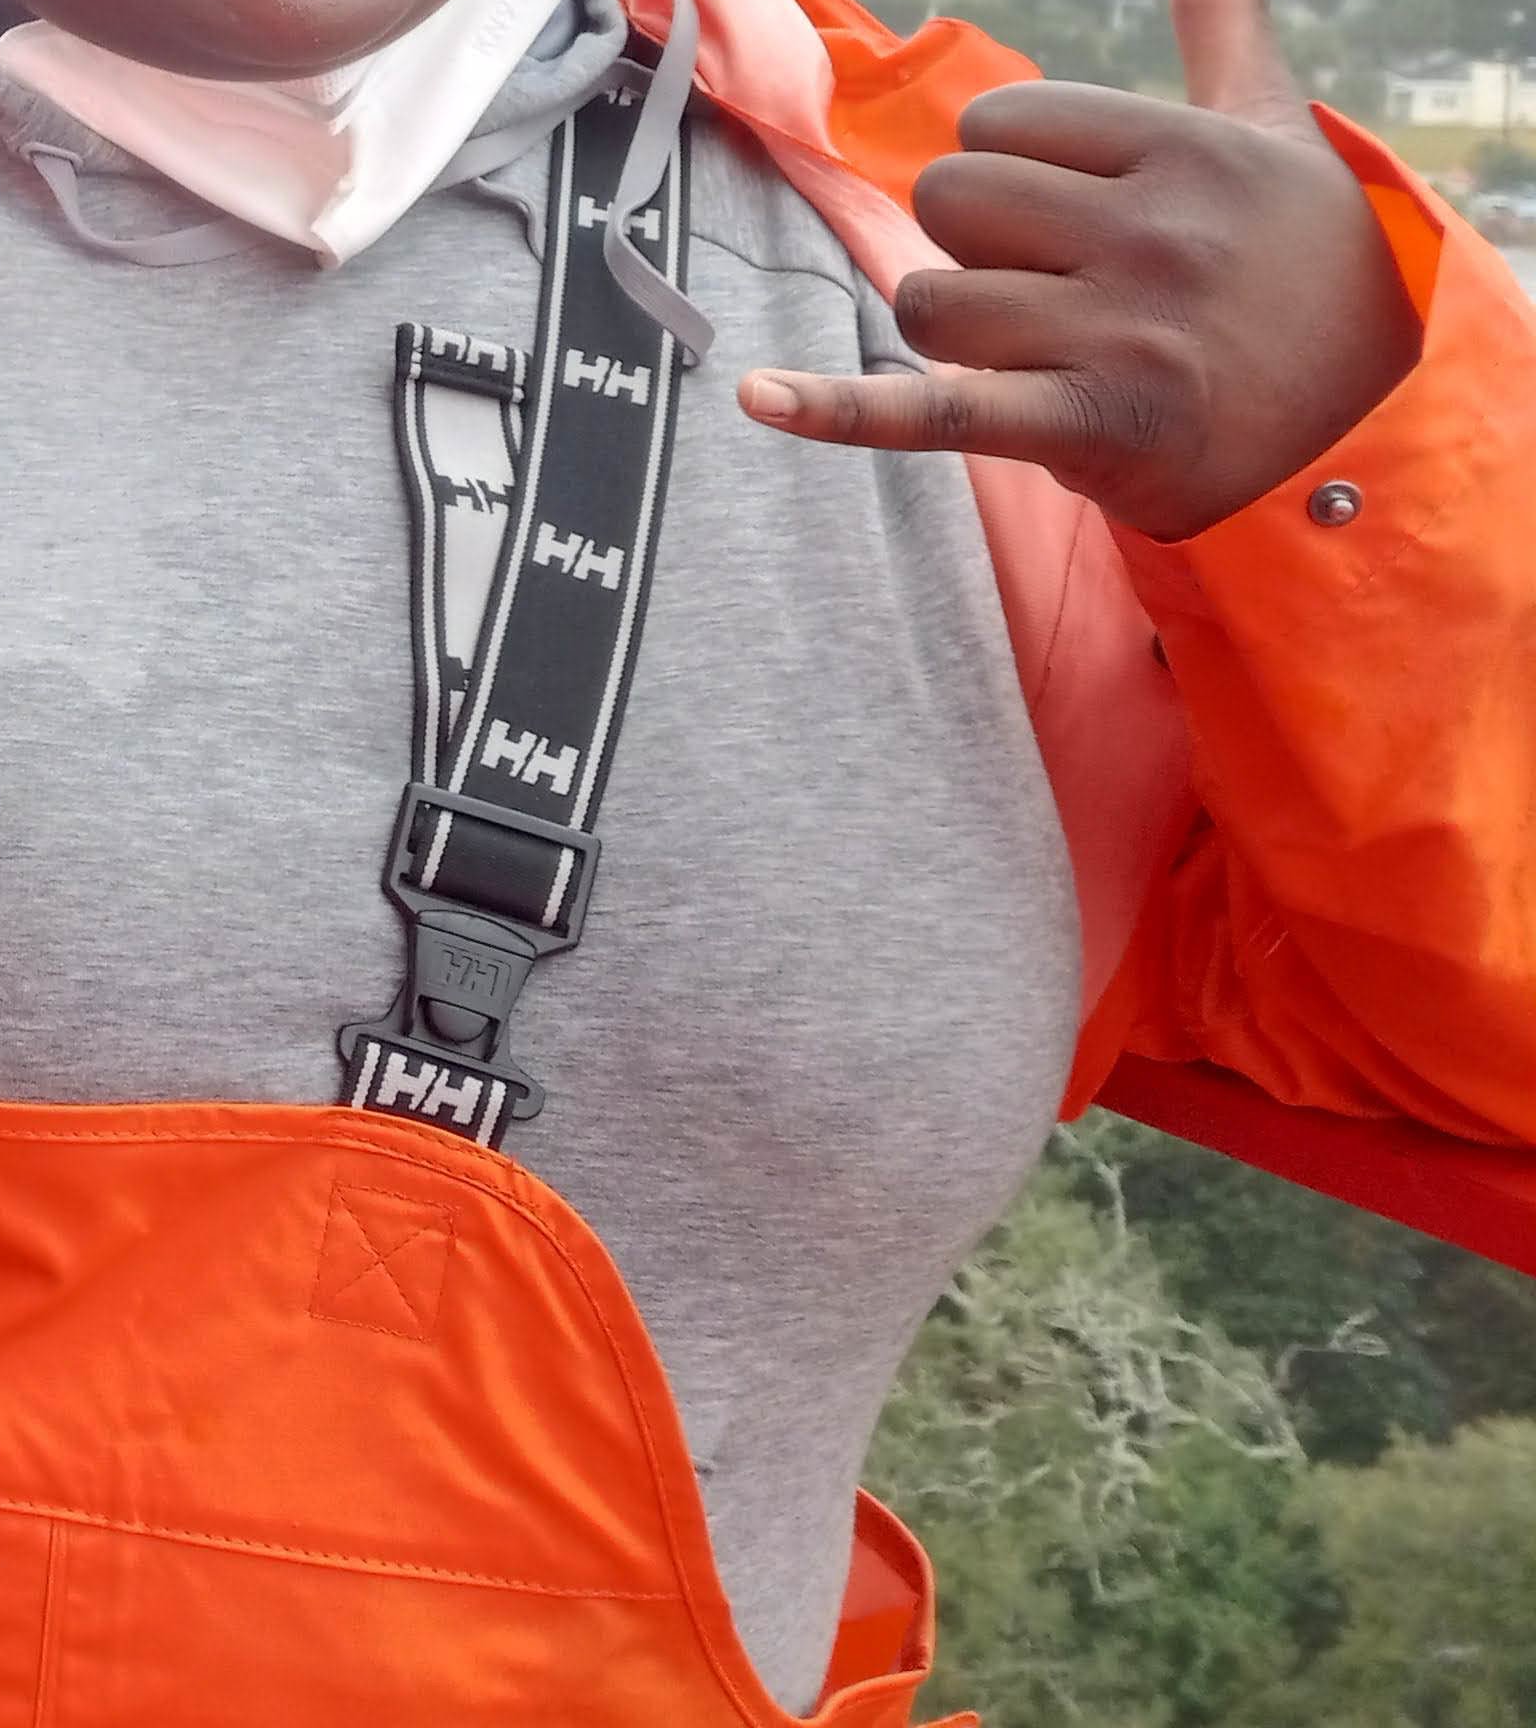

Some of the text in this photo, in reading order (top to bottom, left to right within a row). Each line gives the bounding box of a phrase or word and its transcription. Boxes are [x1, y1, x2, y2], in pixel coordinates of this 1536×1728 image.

[563, 349, 651, 405] HH
[533, 522, 624, 589] HH
[480, 719, 579, 795] HH
[376, 1052, 483, 1124] HH
